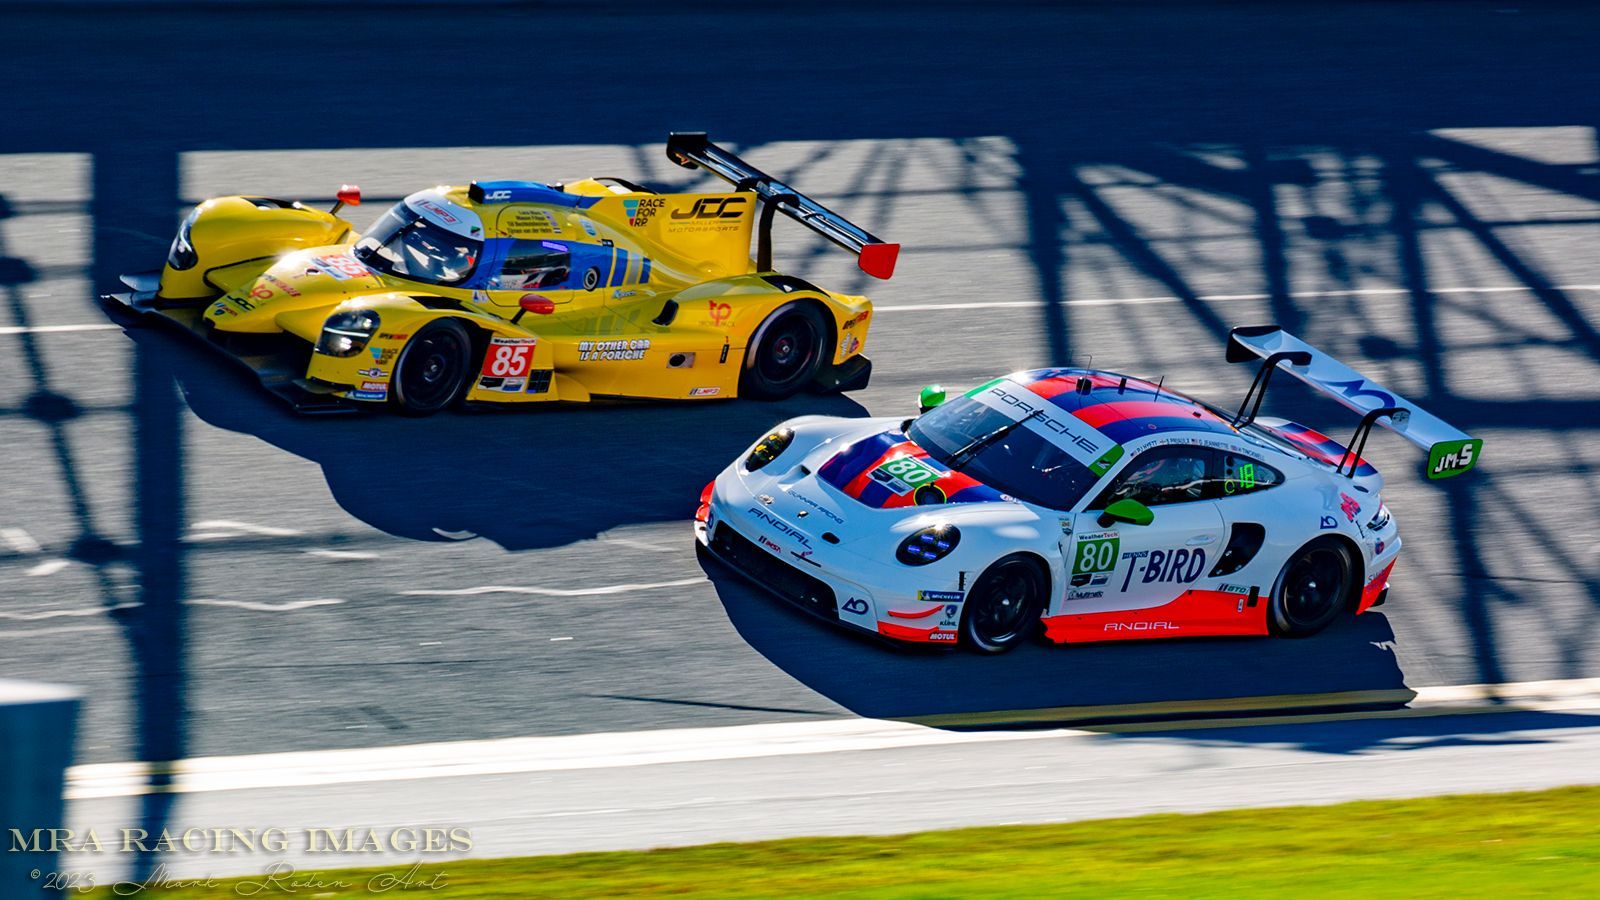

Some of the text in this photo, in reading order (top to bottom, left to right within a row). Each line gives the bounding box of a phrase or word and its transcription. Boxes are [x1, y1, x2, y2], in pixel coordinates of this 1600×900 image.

[638, 198, 666, 208] RACE
[635, 207, 657, 217] FOR
[579, 341, 594, 351] MY
[596, 340, 627, 351] OTHER
[491, 346, 529, 376] 85
[580, 350, 645, 361] IS A PORSCHE
[989, 388, 1100, 454] PORSCHE
[887, 461, 932, 483] 80
[747, 507, 813, 550] ANDIAL
[1078, 532, 1119, 541] WeatherTech
[1080, 541, 1114, 572] 80
[1120, 547, 1206, 593] T-BIRD
[1104, 621, 1180, 632] ANDIAL
[929, 632, 956, 640] MOTUL
